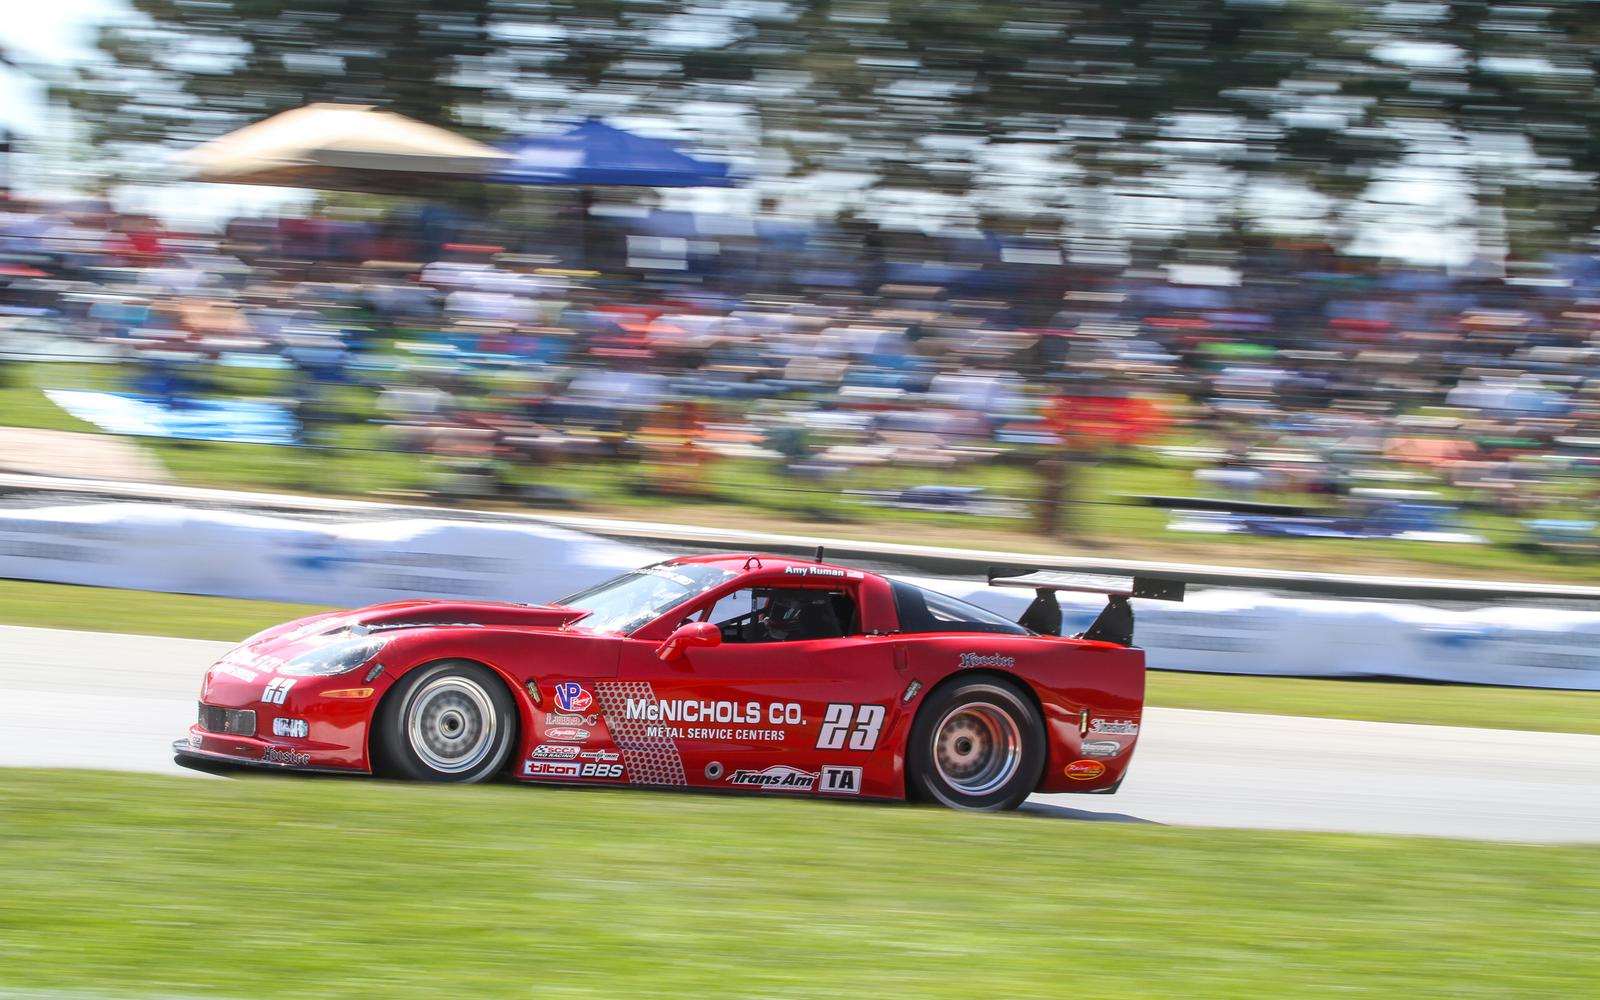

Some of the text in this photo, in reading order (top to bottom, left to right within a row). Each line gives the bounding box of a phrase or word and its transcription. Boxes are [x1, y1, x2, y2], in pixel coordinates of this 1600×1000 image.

[784, 565, 845, 577] Amy Ruman
[958, 652, 1015, 668] Hoosier
[261, 677, 298, 705] 23
[555, 683, 582, 711] VP
[625, 698, 761, 724] McNICHOLS
[768, 702, 807, 726] CO.
[647, 727, 785, 741] METAL SERVICE CENTERS
[815, 702, 887, 752] 23
[263, 745, 310, 765] Hoosier
[528, 763, 577, 775] tilton
[581, 763, 624, 777] BBS
[733, 770, 814, 787] Trans Am
[827, 769, 854, 790] TA
